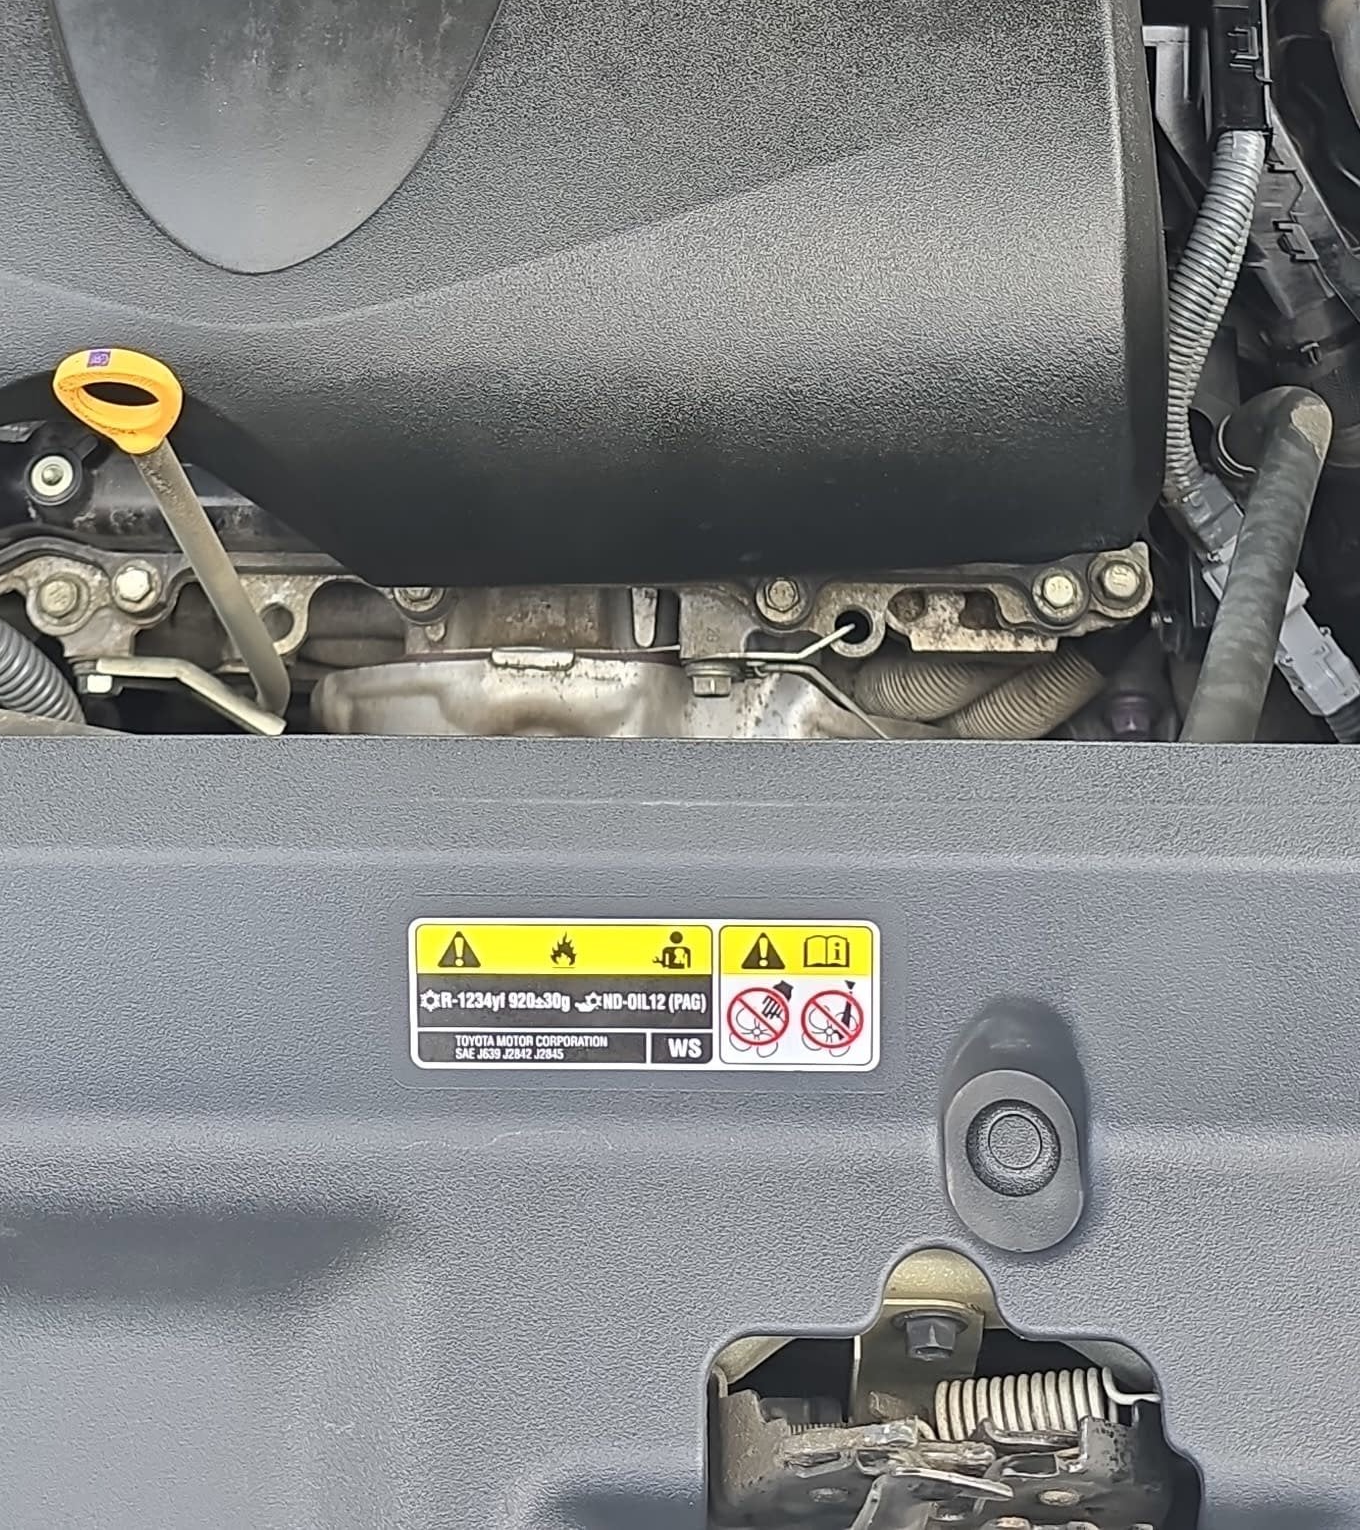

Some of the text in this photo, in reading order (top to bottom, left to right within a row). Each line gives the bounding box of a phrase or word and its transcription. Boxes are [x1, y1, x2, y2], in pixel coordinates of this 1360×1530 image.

[441, 992, 707, 1013] R-1234yf 920±30g ND-OIL12 (PAG)
[455, 1035, 702, 1058] TOYOTA MOTOR CORPORATION WS
[455, 1048, 564, 1060] SAE J639 J2842 J2845
